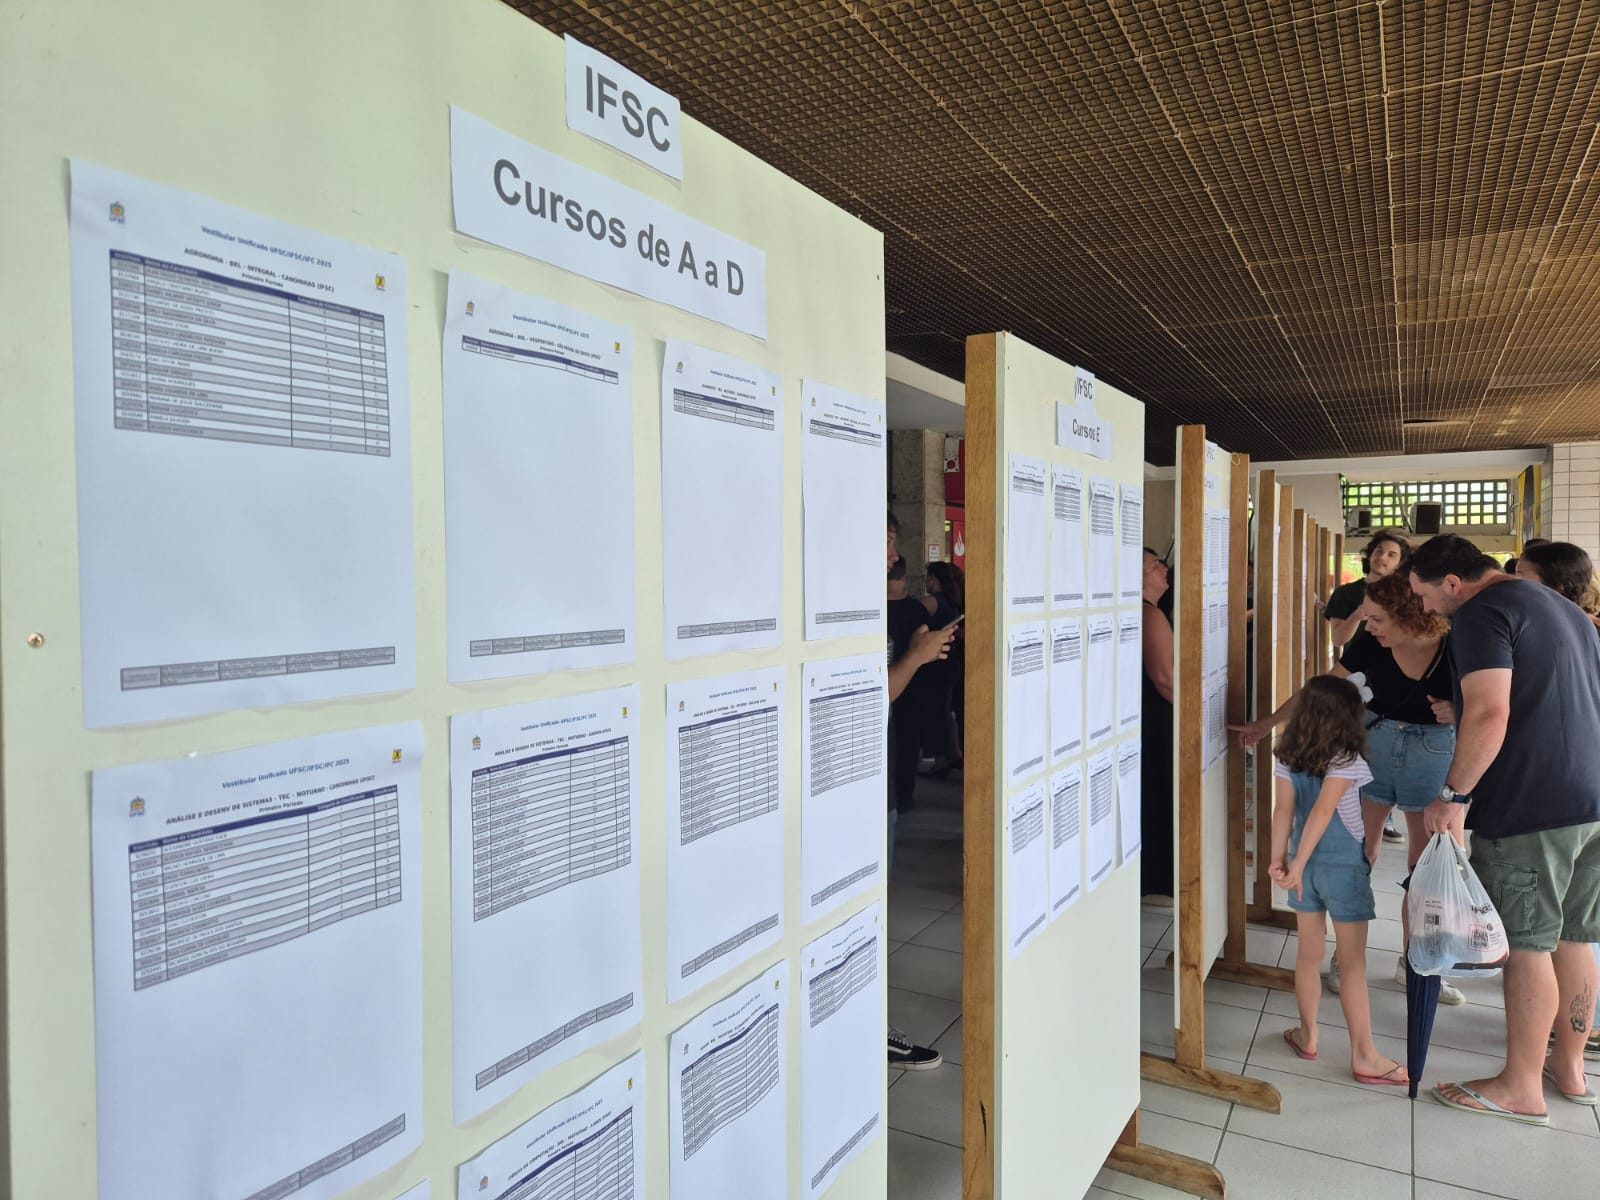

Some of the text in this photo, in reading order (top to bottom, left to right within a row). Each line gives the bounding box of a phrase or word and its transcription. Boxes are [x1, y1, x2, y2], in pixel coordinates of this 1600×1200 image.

[585, 65, 670, 152] IFSC
[201, 225, 236, 242] Vestibular
[493, 158, 744, 296] Cursos de A a D
[1076, 376, 1093, 400] IFSC
[1072, 418, 1101, 442] Cursos E
[222, 775, 257, 790] Vestibular
[258, 769, 288, 782] Unificado
[242, 796, 273, 811] SISTEMAS
[296, 786, 326, 798] NOTURNO
